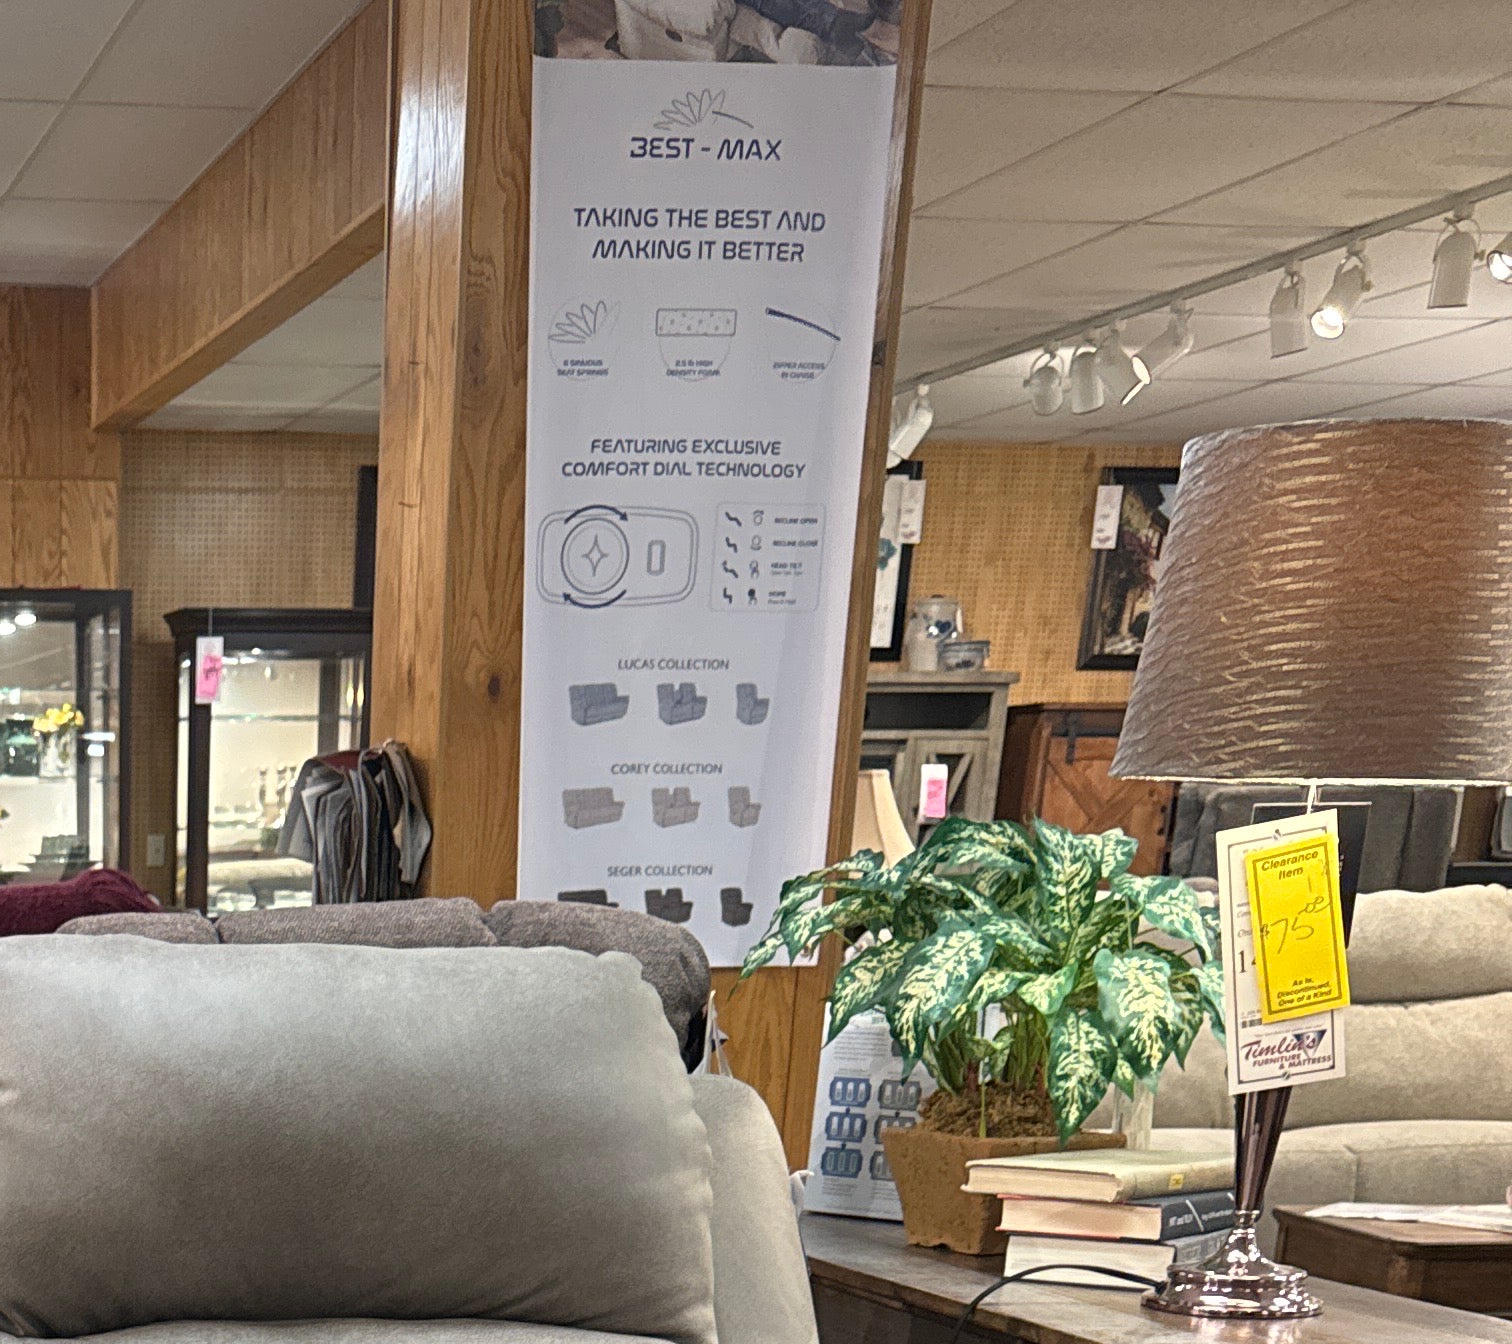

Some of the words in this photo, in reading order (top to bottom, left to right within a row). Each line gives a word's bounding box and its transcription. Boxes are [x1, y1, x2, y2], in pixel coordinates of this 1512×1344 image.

[630, 136, 695, 159] BEST
[717, 139, 782, 161] MAX
[574, 207, 658, 228] TAKING
[665, 208, 708, 228] THE
[715, 209, 772, 230] BEST
[776, 211, 826, 232] AND
[592, 239, 691, 259] MAKING
[698, 240, 716, 260] IT
[722, 241, 805, 263] BETTER
[590, 439, 687, 454] FEATURING
[691, 439, 781, 456] EXCLUSIVE
[561, 462, 649, 477] COMFORT
[653, 462, 692, 477] DIAL
[697, 462, 805, 478] TECHNOLOGY
[617, 658, 655, 670] LUCAS
[657, 659, 730, 670] COLLECTION
[610, 763, 650, 775] COREY
[653, 763, 723, 774] COLLECTION
[1261, 850, 1319, 872] Clearance
[607, 866, 642, 877] SEGER
[644, 865, 713, 876] COLLECTION
[1278, 866, 1304, 880] Item
[1278, 997, 1295, 1007] One
[1297, 994, 1305, 1003] of
[1240, 1033, 1317, 1060] Timlin's
[1252, 1053, 1302, 1067] FURNITURE
[1278, 1061, 1285, 1070] &
[1287, 1055, 1332, 1068] MATTRESS
